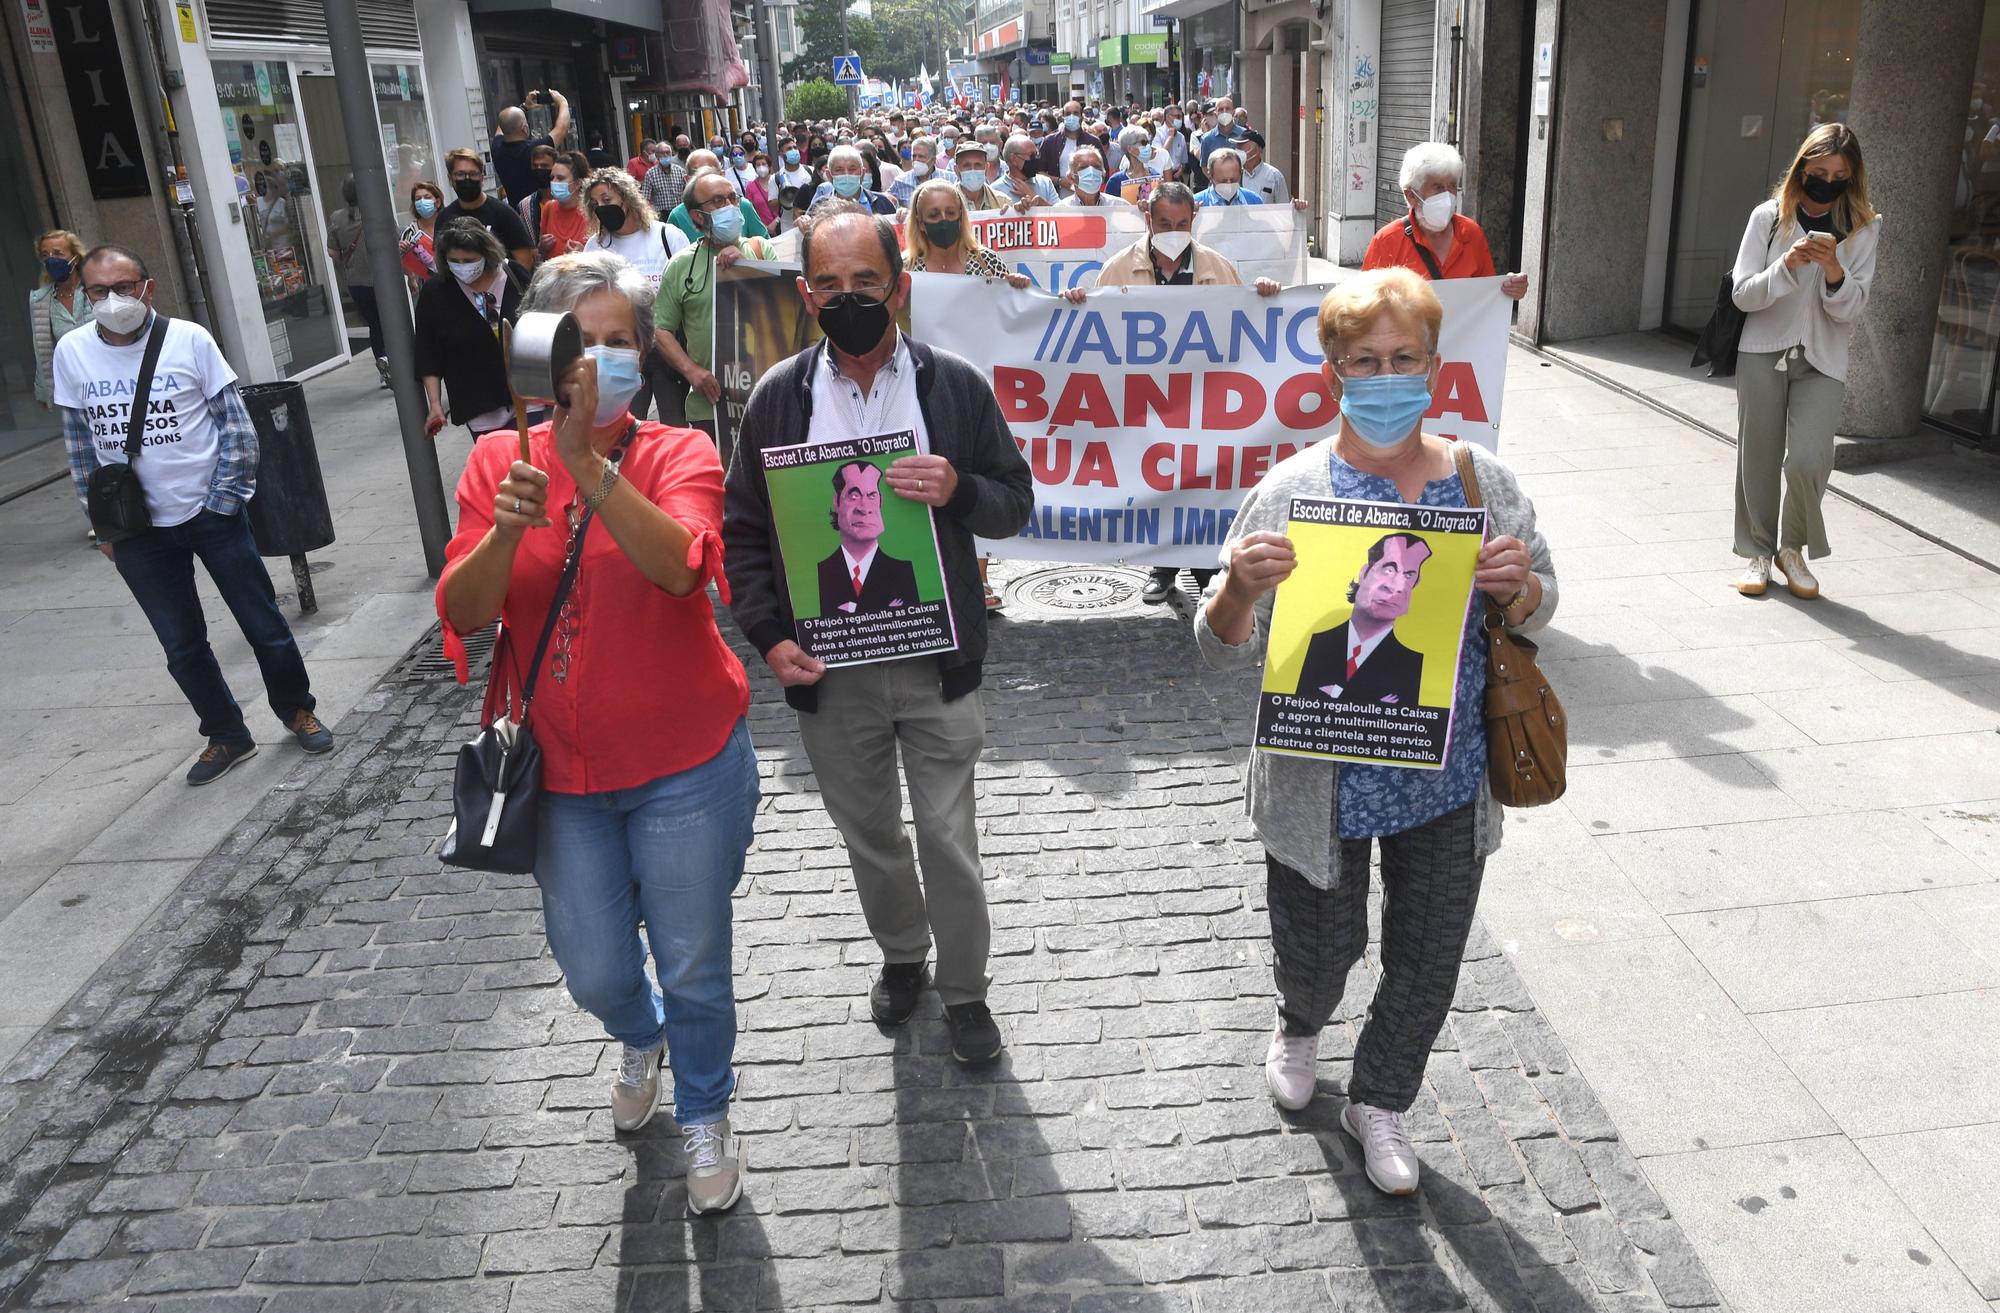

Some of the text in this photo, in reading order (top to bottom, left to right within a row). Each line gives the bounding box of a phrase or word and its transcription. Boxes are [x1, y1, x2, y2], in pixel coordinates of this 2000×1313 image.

[986, 221, 1034, 248] PECHE
[1037, 220, 1059, 246] DA
[994, 362, 1489, 430] BANDOA
[88, 403, 130, 420] BAST
[95, 416, 179, 436] DE ABSOS
[103, 432, 182, 450] IMPOCIÓNS
[763, 452, 798, 468] Escotet
[804, 450, 817, 462] de
[819, 444, 858, 460] Abanca,
[1014, 426, 1119, 488] ÚA
[1019, 497, 1238, 545] ALENTÍN IMP
[1292, 500, 1337, 521] Escotet
[1339, 504, 1346, 522] I
[1347, 504, 1362, 523] de
[1364, 507, 1412, 528] Abanca,
[804, 603, 940, 629] O Feijoó regaloulle as Caixas
[811, 641, 836, 652] deixa
[846, 634, 886, 647] clientela
[888, 633, 906, 641] sen
[907, 627, 942, 639] servizo
[813, 632, 819, 640] e
[821, 629, 848, 641] agora
[850, 627, 856, 635] é
[851, 650, 863, 658] os
[864, 645, 896, 658] postos
[898, 642, 910, 652] de
[911, 636, 952, 650] traballo.
[1272, 695, 1439, 720] O Feijoó regaloulle as Caixas
[1270, 723, 1432, 747] deixa a clientela sen servizo
[1278, 711, 1428, 734] e agora é multimillonario,
[1269, 736, 1313, 750] destrue
[1316, 742, 1329, 751] os
[1332, 743, 1371, 755] postos
[1373, 746, 1388, 757] de
[1391, 748, 1439, 761] traballo.
